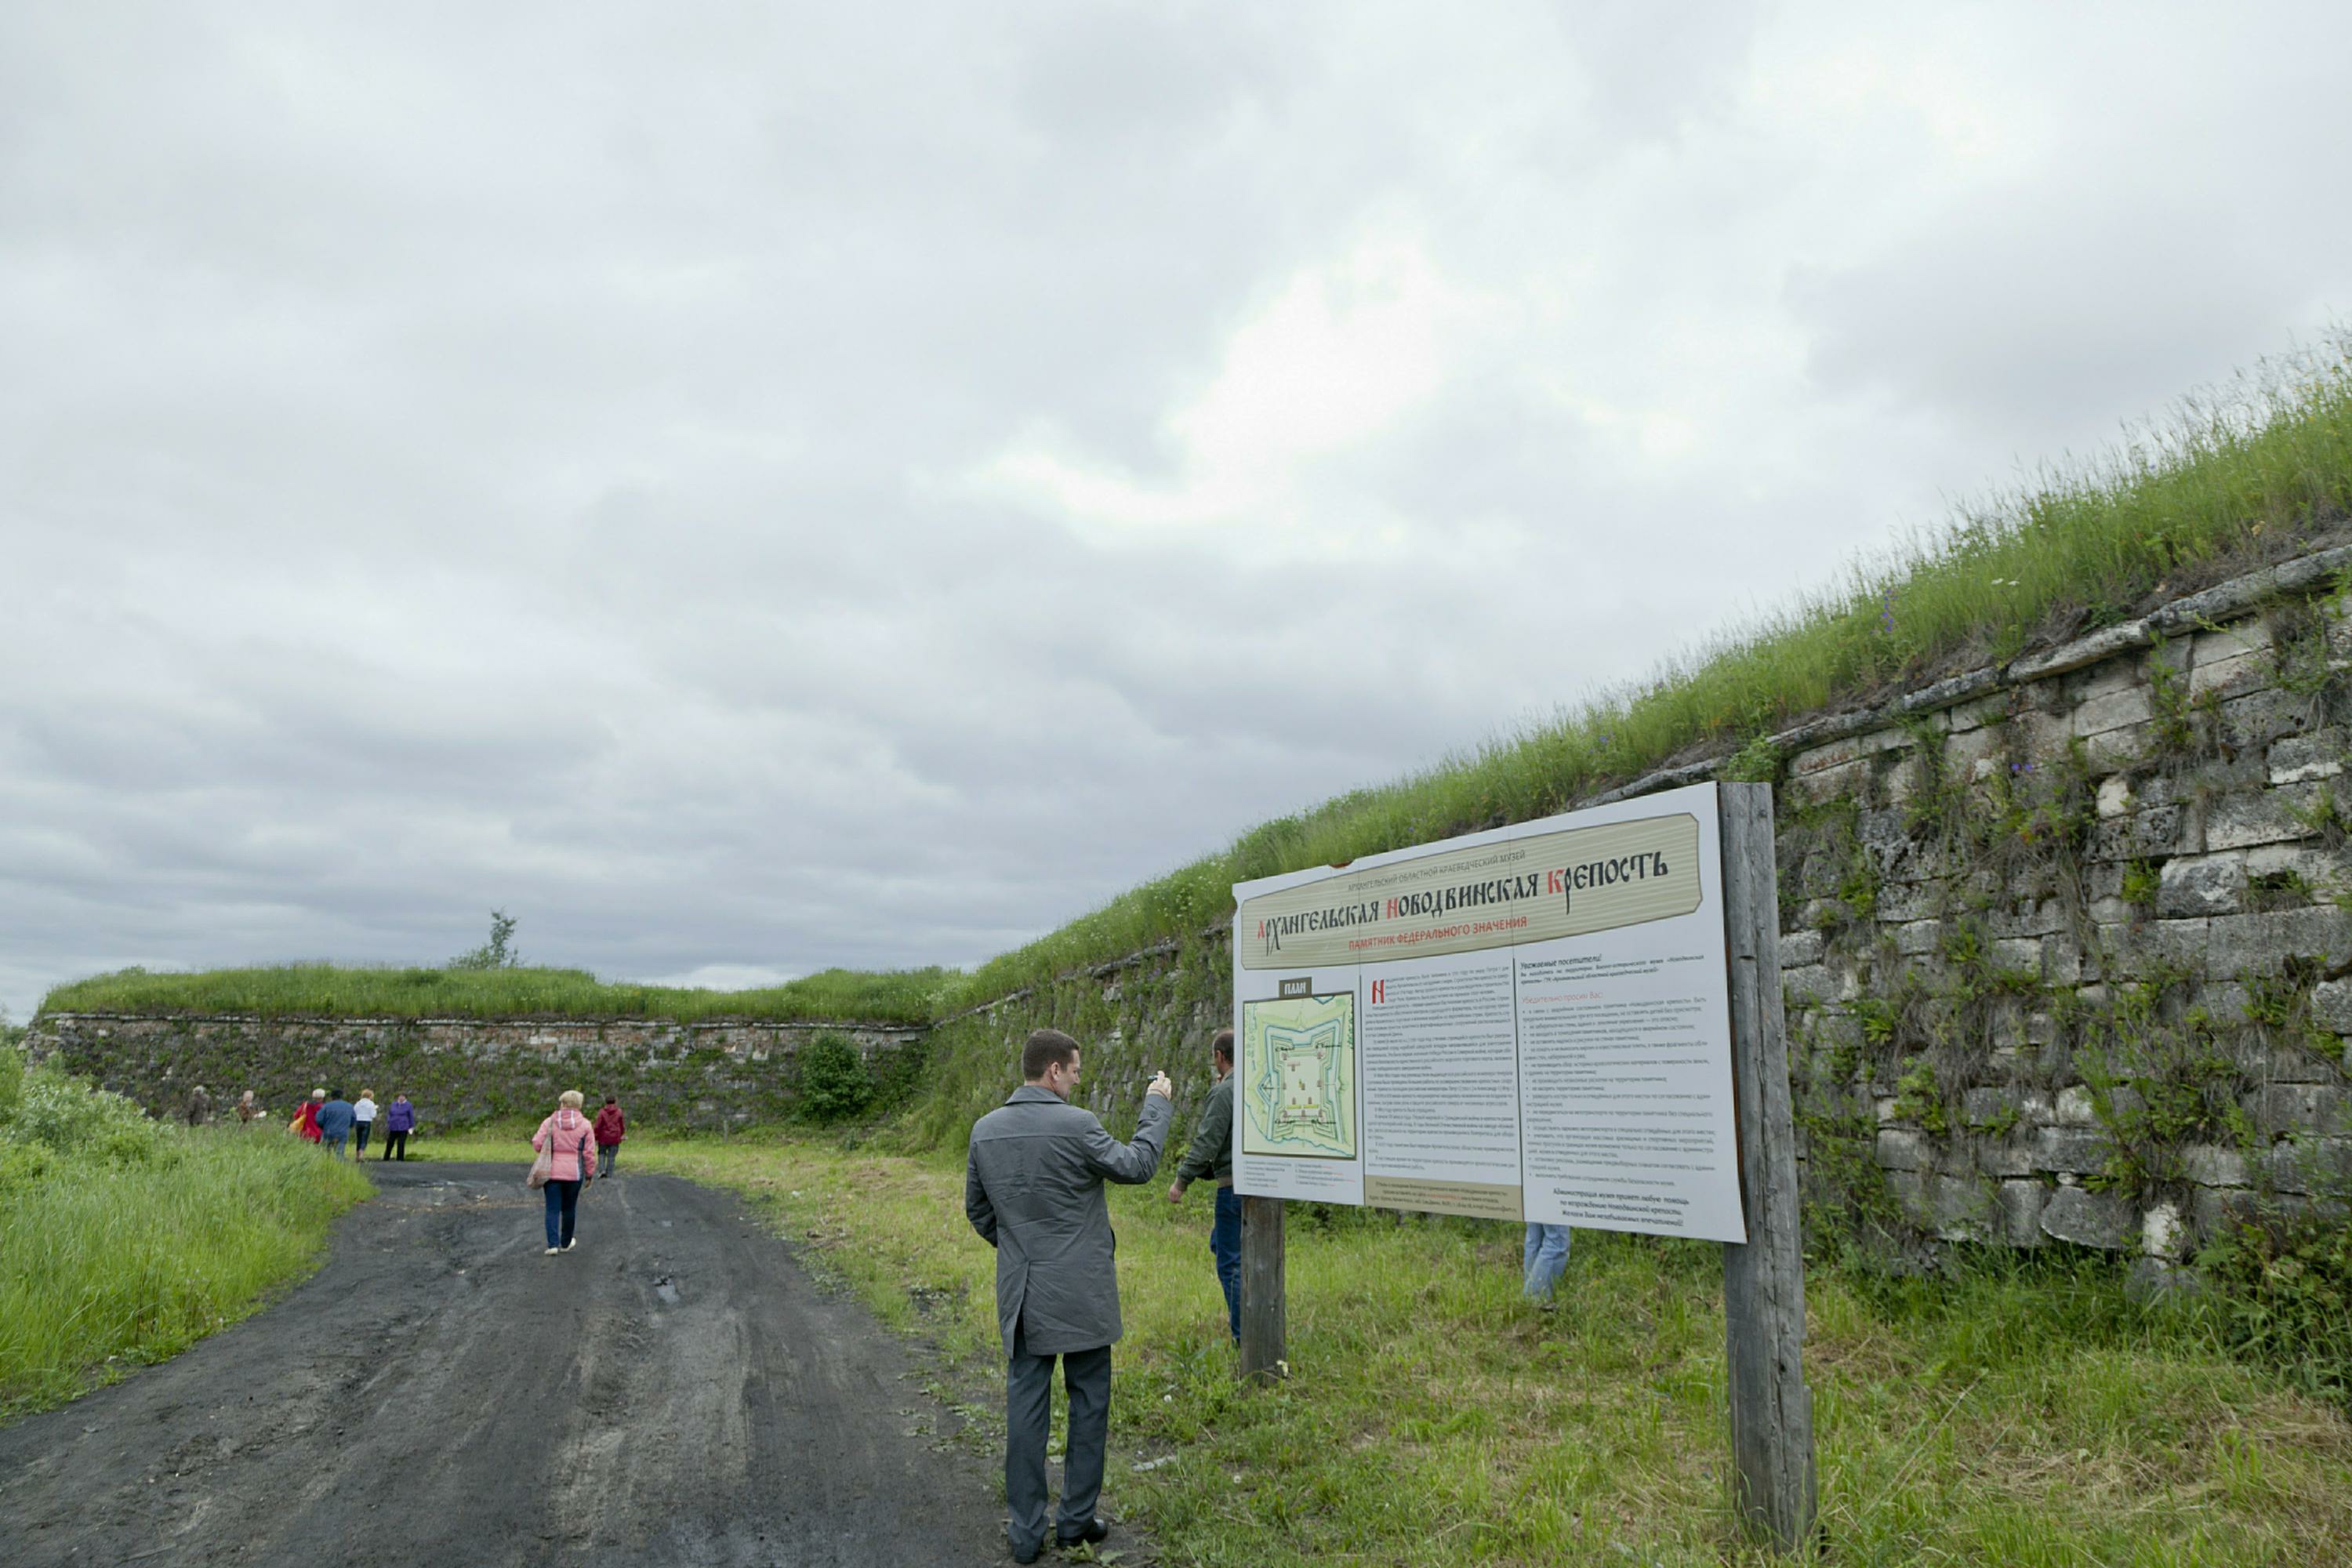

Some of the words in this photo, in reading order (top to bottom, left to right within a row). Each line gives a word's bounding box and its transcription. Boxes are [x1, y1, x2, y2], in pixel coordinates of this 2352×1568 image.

[1348, 874, 1398, 891] АРХАНГЕЛЬСКИЙ
[1399, 867, 1439, 884] ОБЛАСТНОЙ
[1439, 854, 1498, 877] КРАЕВЕДЧЕСКИЙ
[1500, 849, 1526, 863] МУЗЕЙ
[1348, 935, 1396, 951] ПАМЯТНИК
[1396, 924, 1470, 943] ФЕДЕРАЛЬНОГО
[1472, 916, 1528, 935] ЗНАЧЕНИЯ
[1284, 982, 1306, 995] ПЛАН
